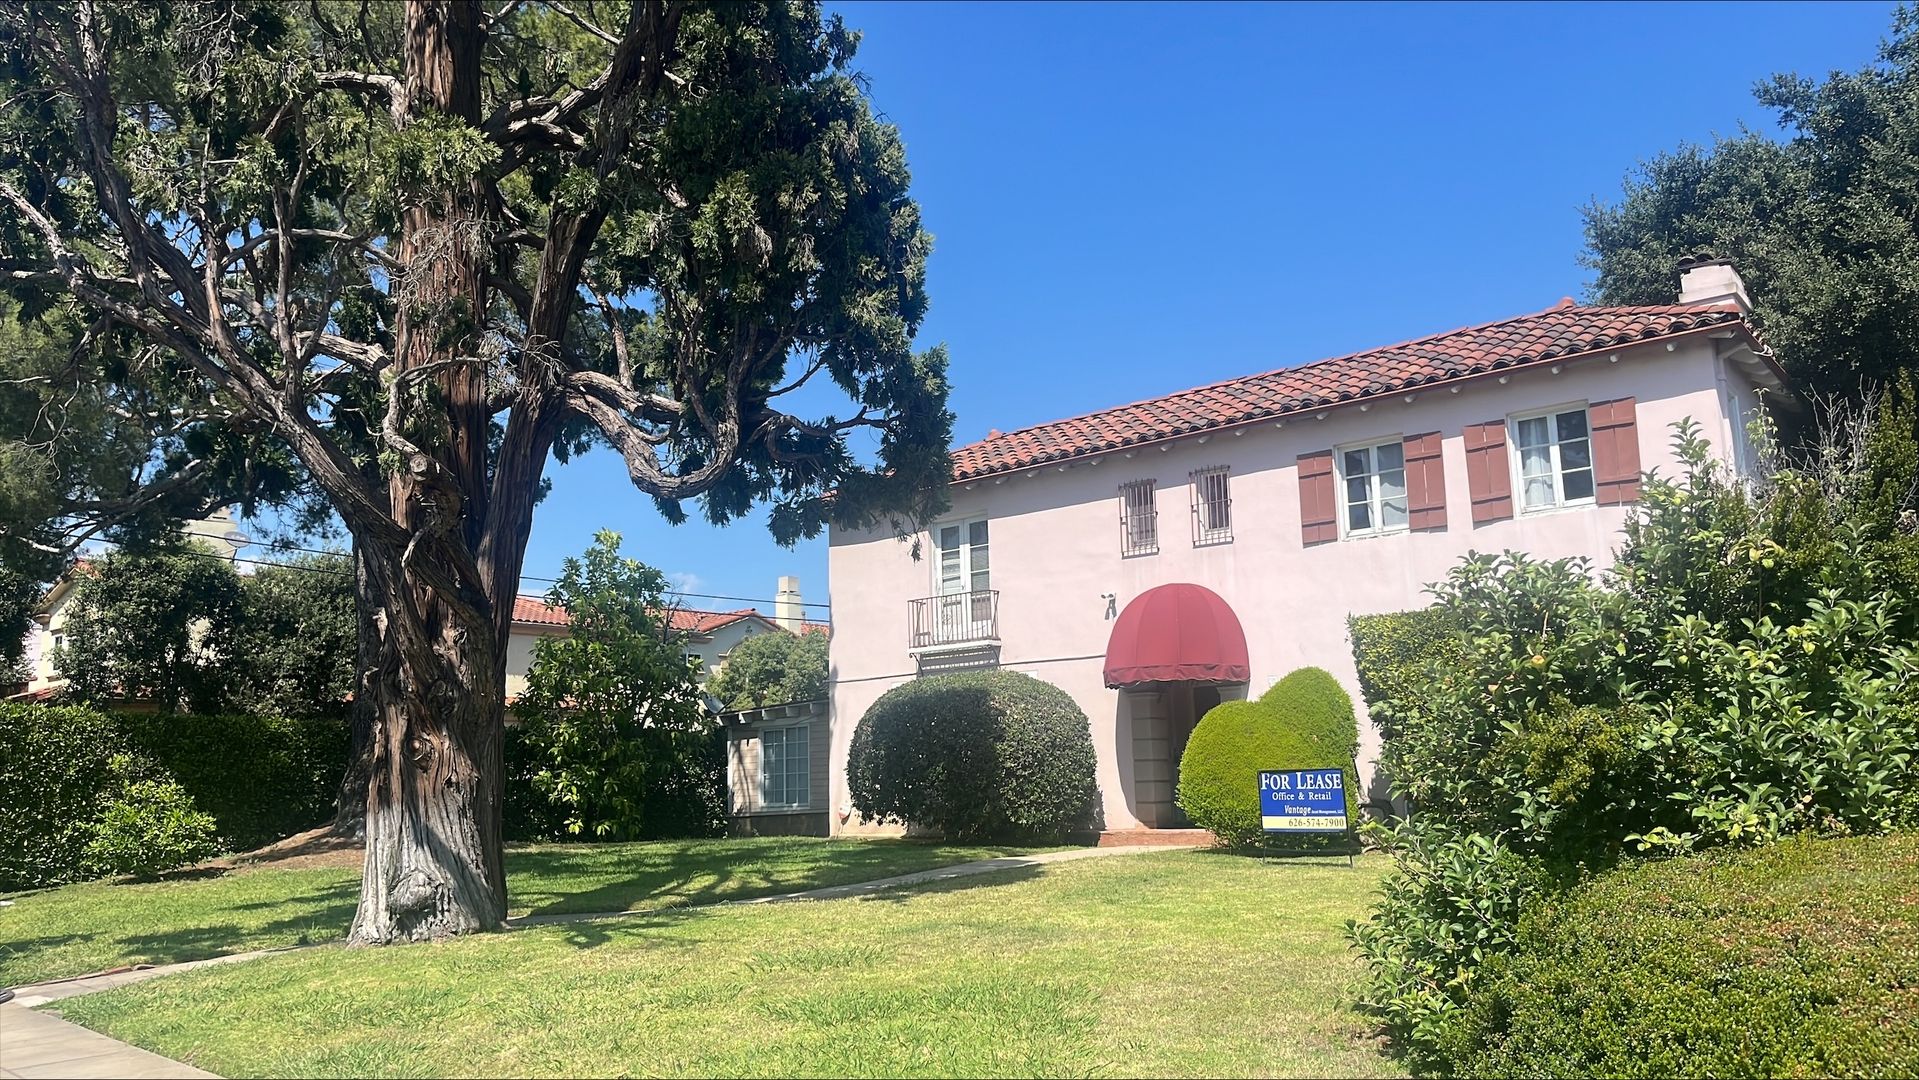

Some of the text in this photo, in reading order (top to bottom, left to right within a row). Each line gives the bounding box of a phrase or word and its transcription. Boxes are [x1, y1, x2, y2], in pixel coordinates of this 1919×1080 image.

[1261, 772, 1342, 790] FOR LEASE
[1272, 791, 1332, 801] Office & Retail
[1284, 805, 1311, 816] Vantage
[1288, 818, 1344, 827] 626-574-7900
